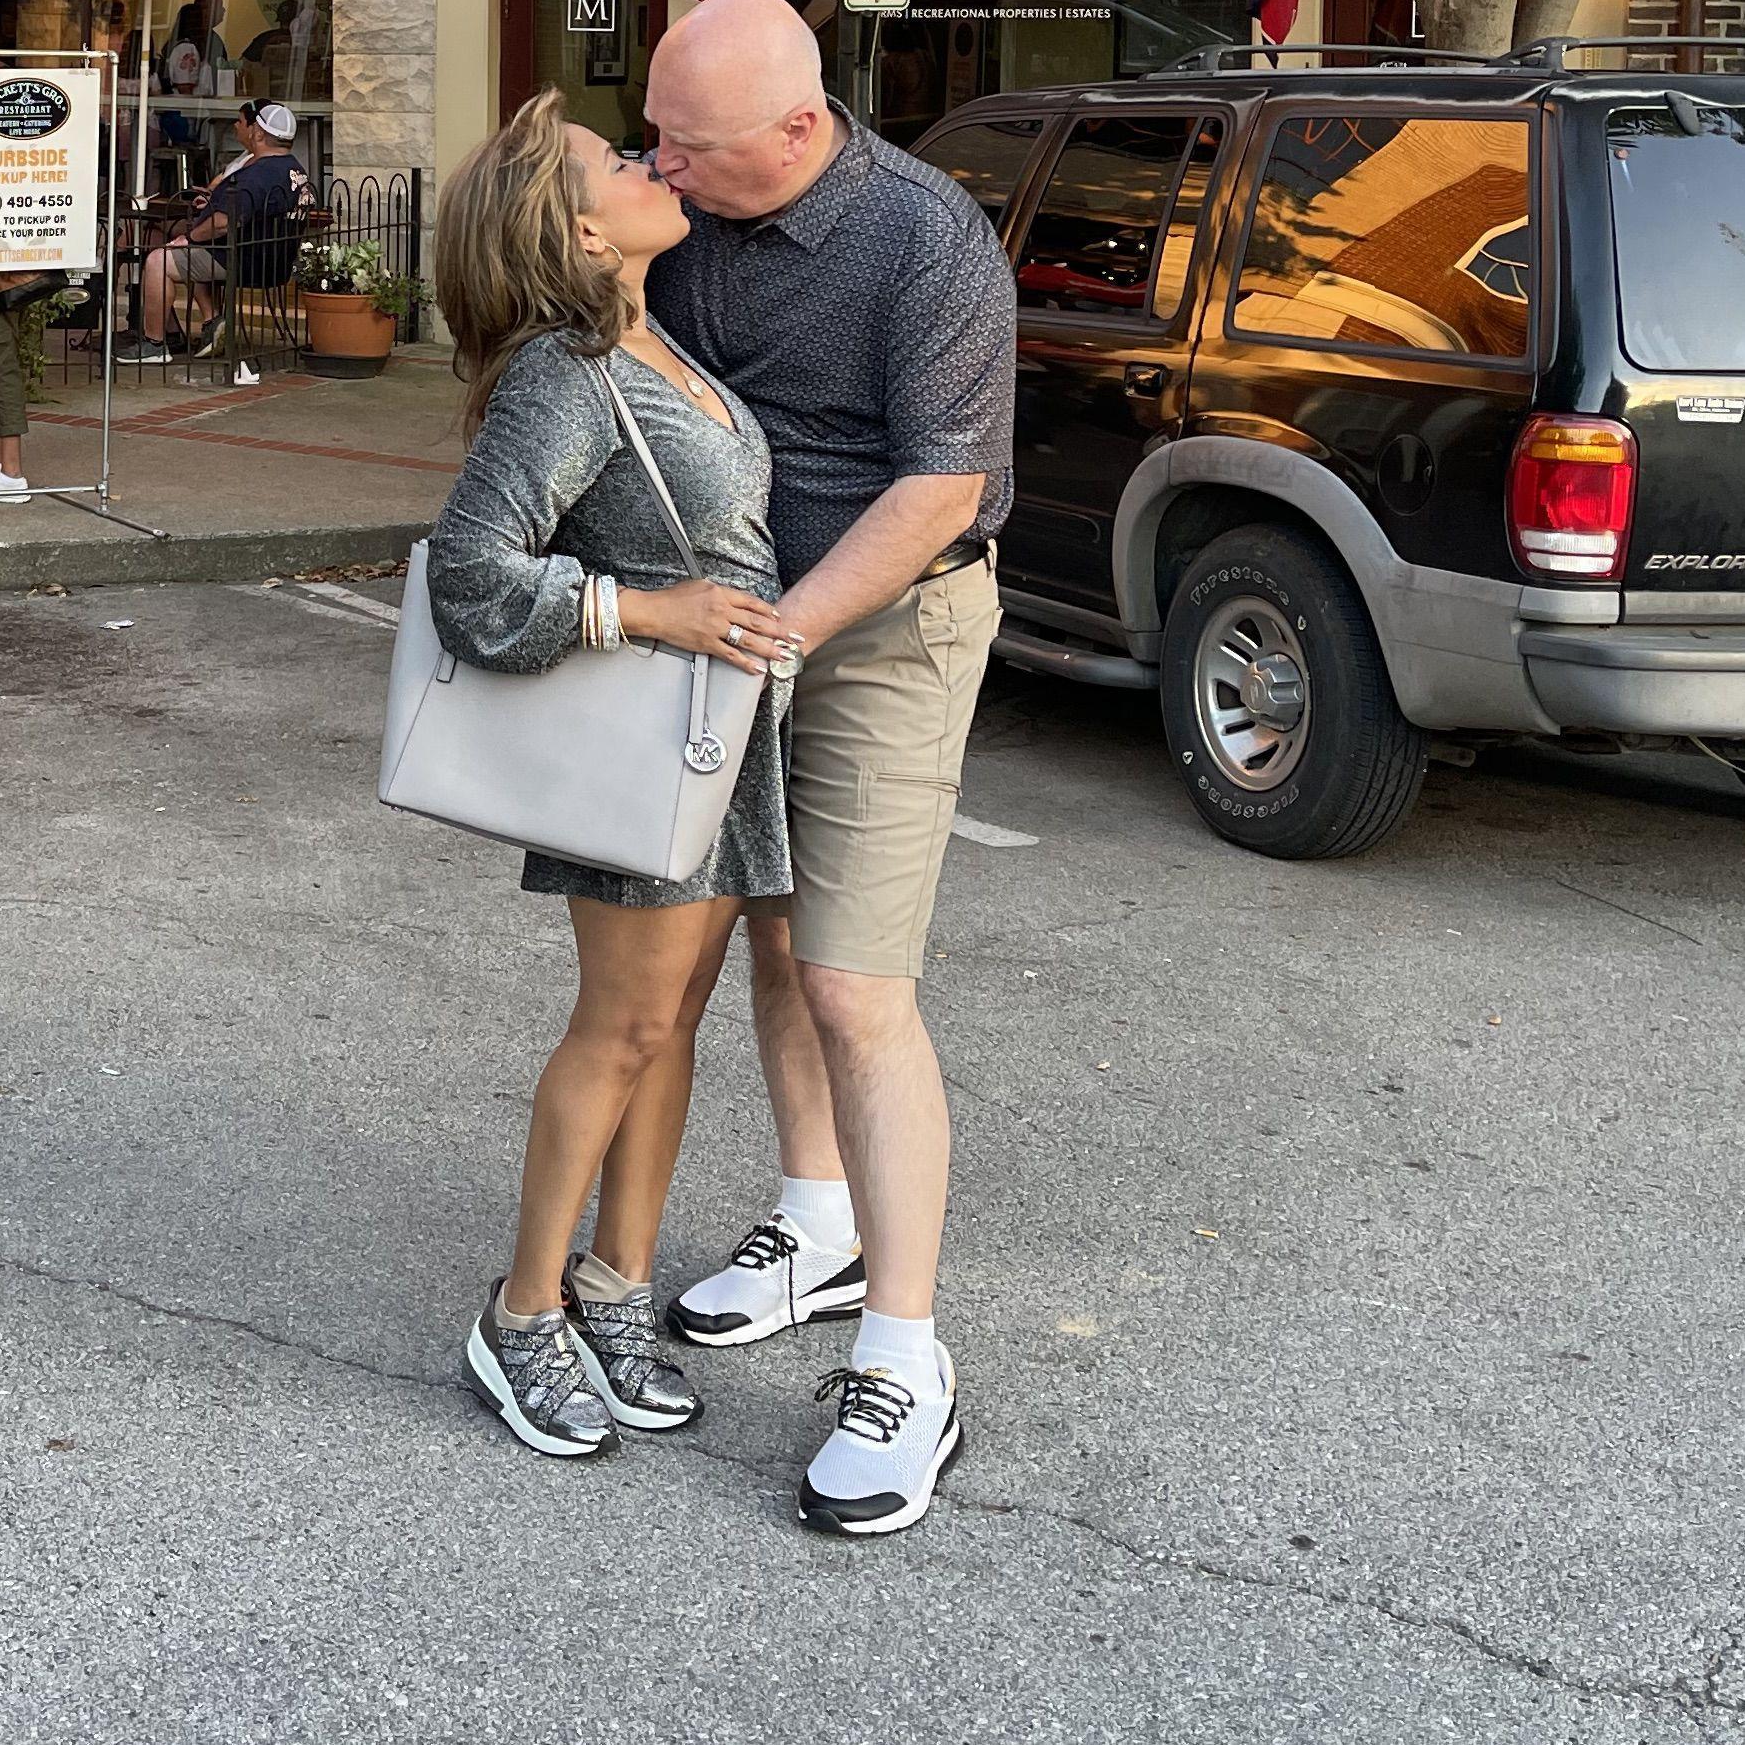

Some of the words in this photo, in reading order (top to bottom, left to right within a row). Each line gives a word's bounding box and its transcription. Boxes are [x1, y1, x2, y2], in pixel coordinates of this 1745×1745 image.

[879, 9, 903, 18] RMS
[911, 8, 991, 19] RECREATIONAL
[993, 8, 1057, 19] PROPERTIES
[1065, 8, 1111, 19] ESTATES
[31, 170, 68, 183] HERE!
[7, 194, 73, 208] 490-4550
[4, 216, 16, 225] TO
[17, 215, 51, 225] PICKUP
[53, 214, 67, 223] OR
[10, 229, 34, 238] YOUR
[36, 227, 67, 237] ORDER
[1189, 565, 1290, 606] Firestone
